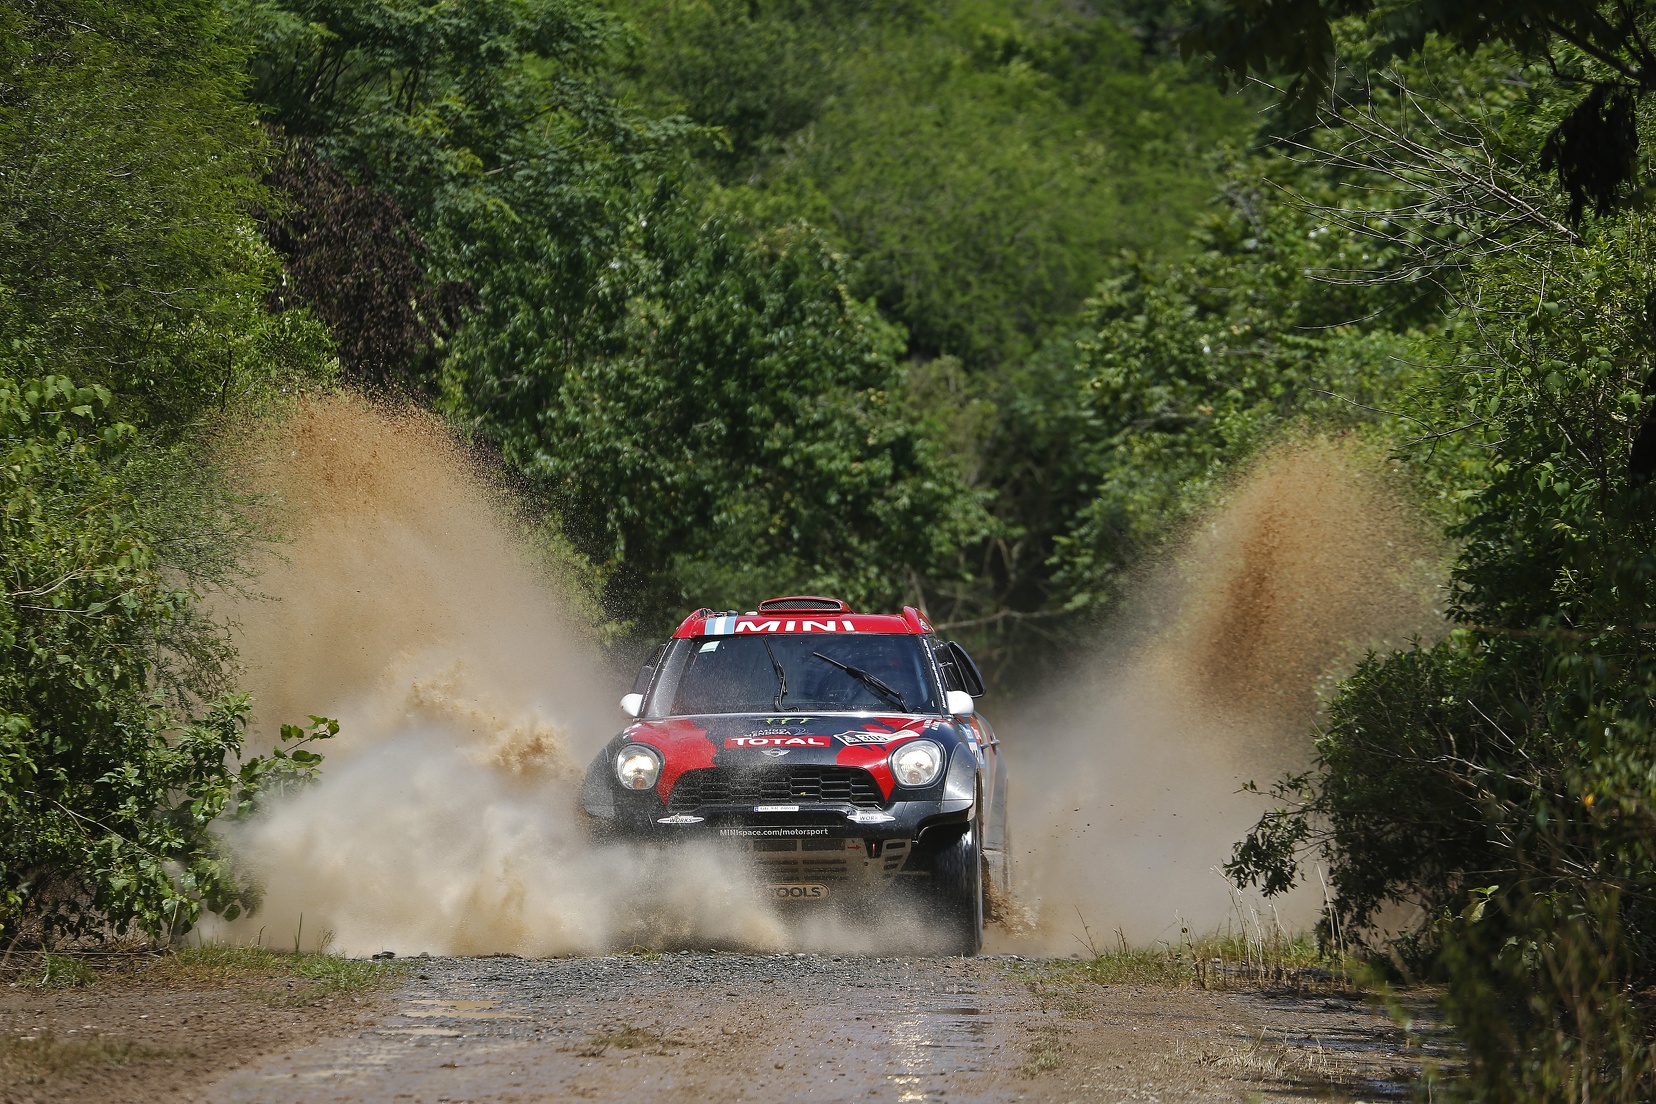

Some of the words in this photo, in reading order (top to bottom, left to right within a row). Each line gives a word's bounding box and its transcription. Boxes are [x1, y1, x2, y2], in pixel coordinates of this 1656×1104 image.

[735, 620, 855, 632] MINI
[731, 737, 825, 746] TOTAL
[719, 827, 829, 837] MINIspace.com/motorsport
